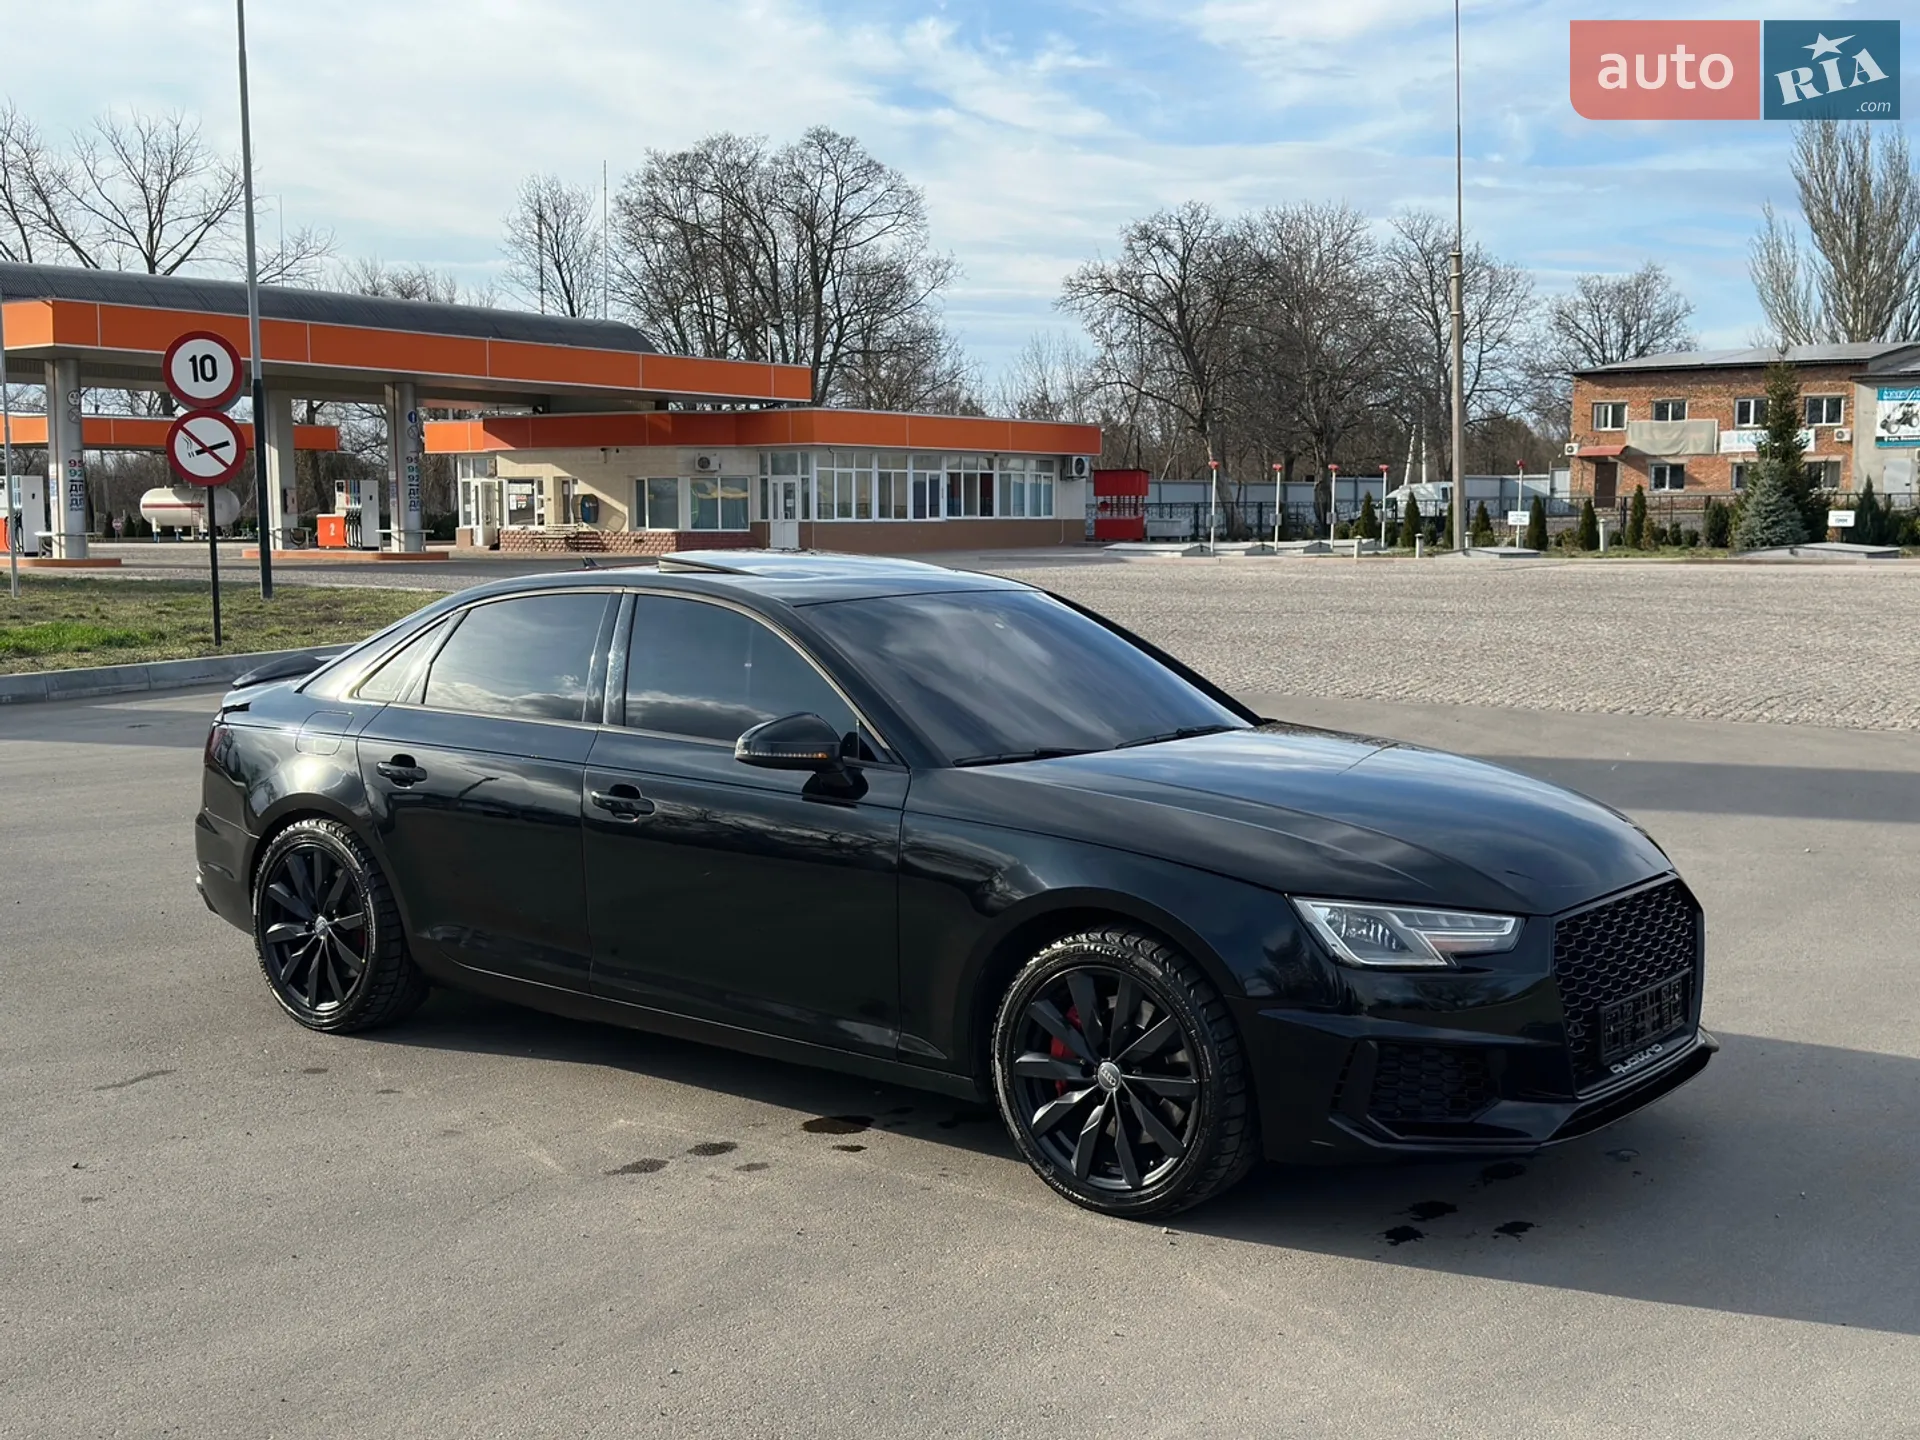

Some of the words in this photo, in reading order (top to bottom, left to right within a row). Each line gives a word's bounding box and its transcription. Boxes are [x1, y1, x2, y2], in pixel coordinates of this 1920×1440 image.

[188, 353, 218, 383] 10
[329, 522, 336, 537] 2
[1609, 1043, 1663, 1074] quattro
